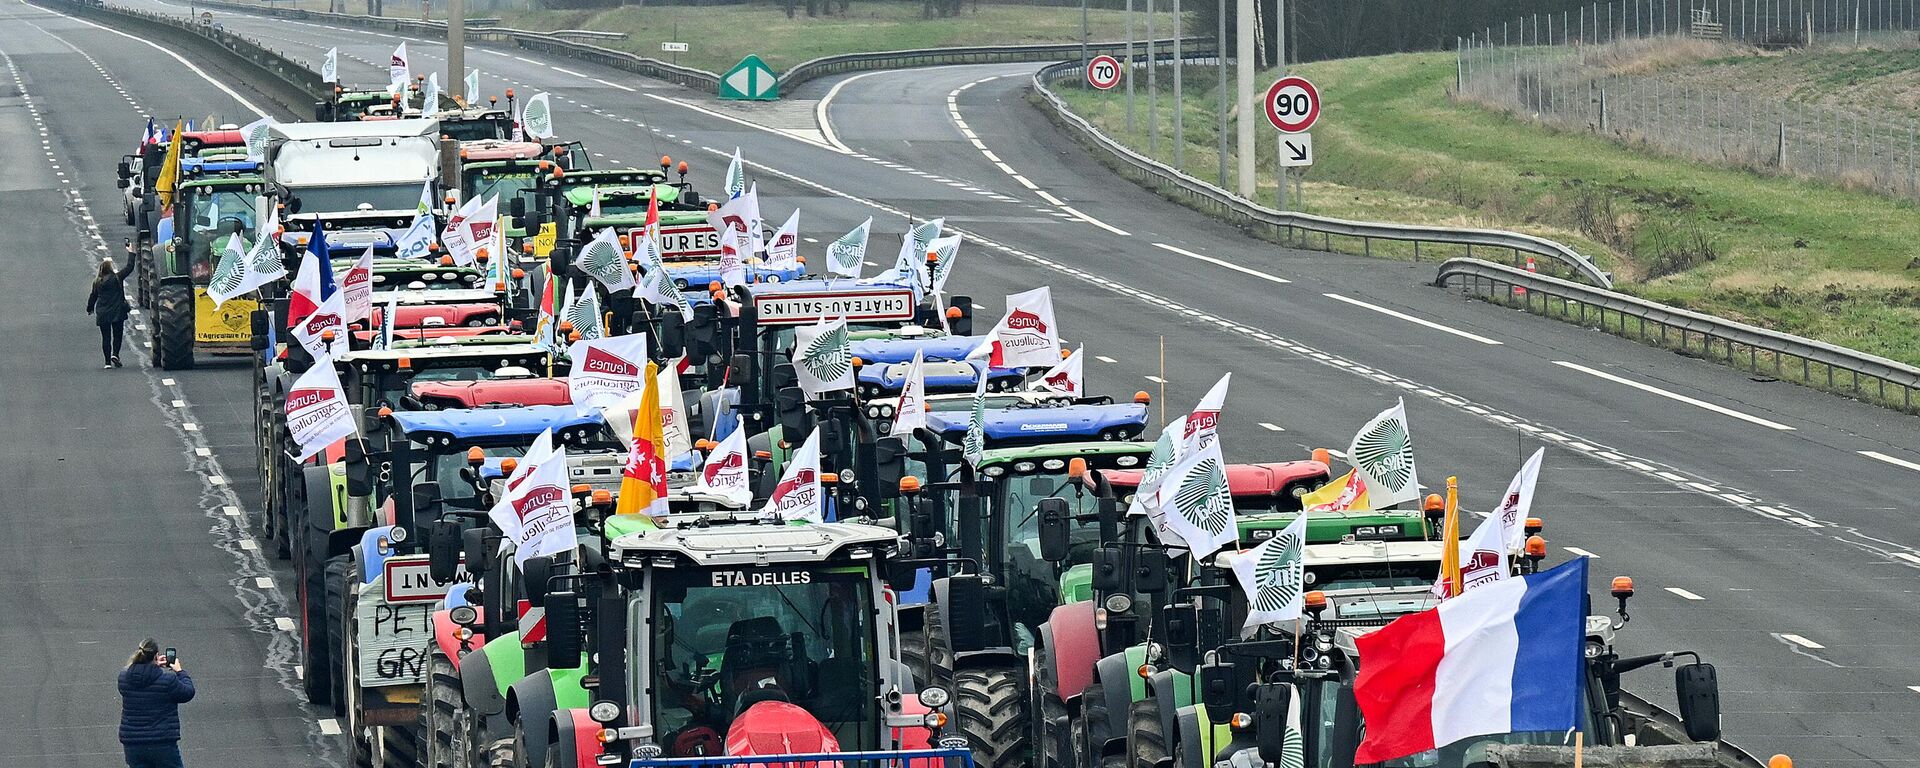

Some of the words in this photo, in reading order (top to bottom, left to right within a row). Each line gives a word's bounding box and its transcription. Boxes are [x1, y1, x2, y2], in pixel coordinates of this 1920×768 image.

[1096, 66, 1113, 80] 70
[1276, 94, 1309, 117] 90
[663, 234, 719, 251] URES
[764, 299, 903, 315] CHÂTEAU-SALINS
[712, 571, 747, 587] ETA
[752, 571, 811, 586] DELLES
